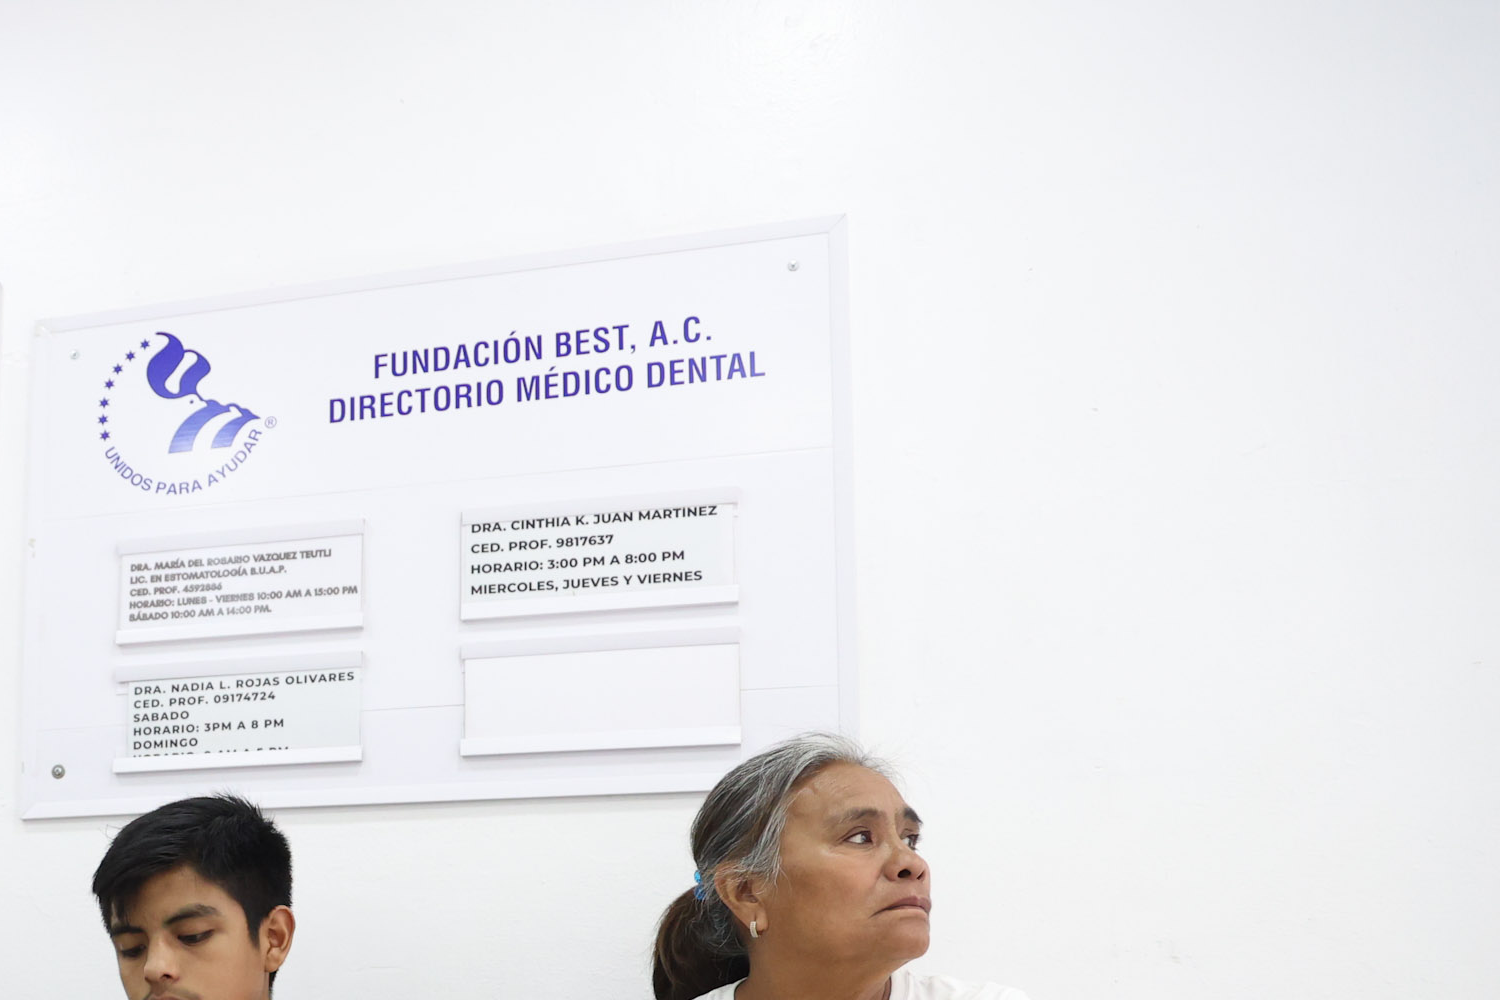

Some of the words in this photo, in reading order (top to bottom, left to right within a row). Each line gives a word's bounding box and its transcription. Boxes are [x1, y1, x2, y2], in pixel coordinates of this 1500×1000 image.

[374, 331, 542, 379] FUNDACIÓN
[556, 324, 636, 359] BEST,
[649, 316, 712, 348] A.C.
[329, 379, 503, 423] DIRECTORIO
[516, 365, 633, 402] MÉDICO
[647, 351, 766, 389] DENTAL
[105, 446, 153, 491] UNIDOS
[155, 480, 203, 495] PARA
[207, 429, 262, 486] AYUDAR
[471, 523, 506, 533] DRA.
[511, 517, 571, 531] CINTHIA
[576, 514, 589, 526] K.
[593, 512, 633, 524] JUAN
[639, 505, 718, 521] MARTINEZ
[471, 543, 504, 554] CED.
[509, 539, 552, 551] PROF.
[556, 534, 614, 548] 9817637
[131, 563, 151, 572] DRA.
[154, 557, 186, 571] MARÍA
[188, 559, 204, 568] DEL
[207, 555, 250, 566] ROSARIO
[253, 551, 297, 563] VAZQUEZ
[300, 549, 331, 559] TEUTLI
[471, 561, 543, 575] HORARIO:
[547, 558, 578, 570] 3:00
[583, 556, 605, 567] PM
[610, 555, 620, 565] A
[625, 552, 657, 564] 8:00
[662, 550, 685, 562] PM
[130, 576, 147, 585] LIC.
[150, 574, 162, 583] EN
[164, 567, 248, 582] ESTOMATOLOGÍA
[251, 565, 287, 575] B.U.A.P.
[471, 580, 559, 595] MIERCOLES,
[563, 576, 619, 590] JUEVES
[623, 575, 633, 586] Y
[637, 570, 702, 584] VIERNES
[129, 600, 174, 610] HORARIO:
[177, 597, 206, 606] LUNES
[216, 593, 254, 604] VIERNES
[257, 591, 282, 601] 10:00
[285, 589, 302, 599] AM
[304, 589, 312, 597] A
[314, 587, 339, 596] 15:00
[342, 586, 358, 595] PM
[130, 588, 151, 597] CED.
[154, 586, 180, 595] PROF.
[129, 611, 168, 622] SÁBADO
[171, 609, 195, 619] 10:00
[198, 608, 215, 617] AM
[217, 607, 224, 616] A
[227, 606, 252, 616] 14:00
[134, 685, 165, 696] DRA.
[171, 682, 214, 693] NADIA
[220, 681, 230, 690] L.
[236, 677, 280, 689] ROJAS
[285, 671, 354, 685] OLIVARES
[134, 699, 164, 709] CED.
[169, 696, 209, 707] PROF.
[214, 691, 276, 704] 09174724
[133, 711, 190, 723] SABADO
[133, 724, 199, 737] HORARIO:
[204, 722, 231, 732] 3PM
[237, 721, 246, 730] A
[251, 720, 258, 729] 8
[264, 719, 284, 729] PM
[133, 738, 198, 750] DOMINGO
